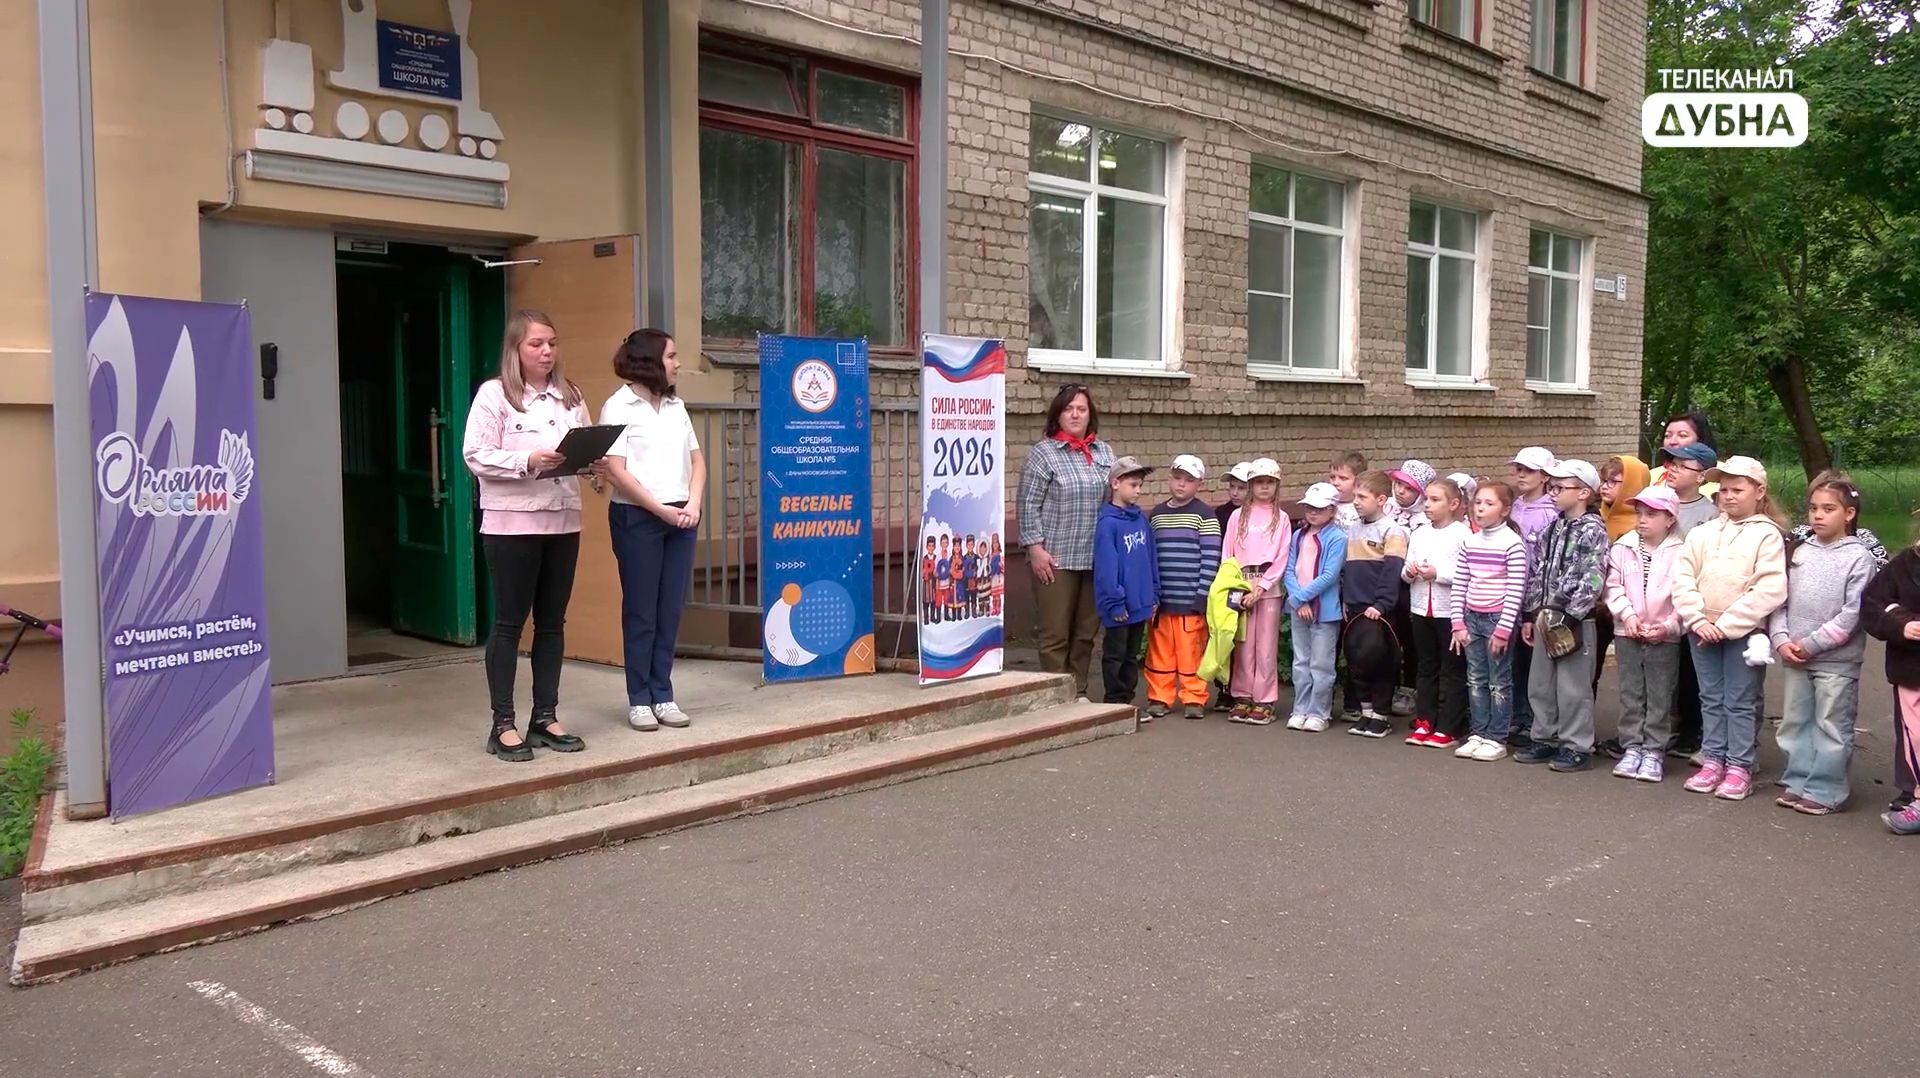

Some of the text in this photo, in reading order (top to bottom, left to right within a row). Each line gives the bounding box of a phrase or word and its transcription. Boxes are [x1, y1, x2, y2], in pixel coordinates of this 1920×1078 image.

[393, 71, 429, 85] ШКОЛА
[931, 396, 995, 415] СИЛА РОССИИ-
[931, 418, 996, 431] В ЕДИНСТВЕ НАРОДОВ!
[771, 445, 860, 454] ОБЩЕОБРАЗОВАТЕЛЬНАЯ
[799, 436, 833, 444] СРЕДНЯЯ
[796, 455, 837, 464] ШКОЛА №5
[933, 436, 994, 477] 2026
[101, 435, 228, 506] Орлята
[137, 492, 228, 513] РОССИИ
[780, 494, 854, 514] ВЕСЕЛЫЕ
[772, 519, 862, 540] КАНИКУЛЫ
[113, 614, 257, 646] «Учимся, растём,
[115, 639, 263, 676] мечтаем вместе!»
